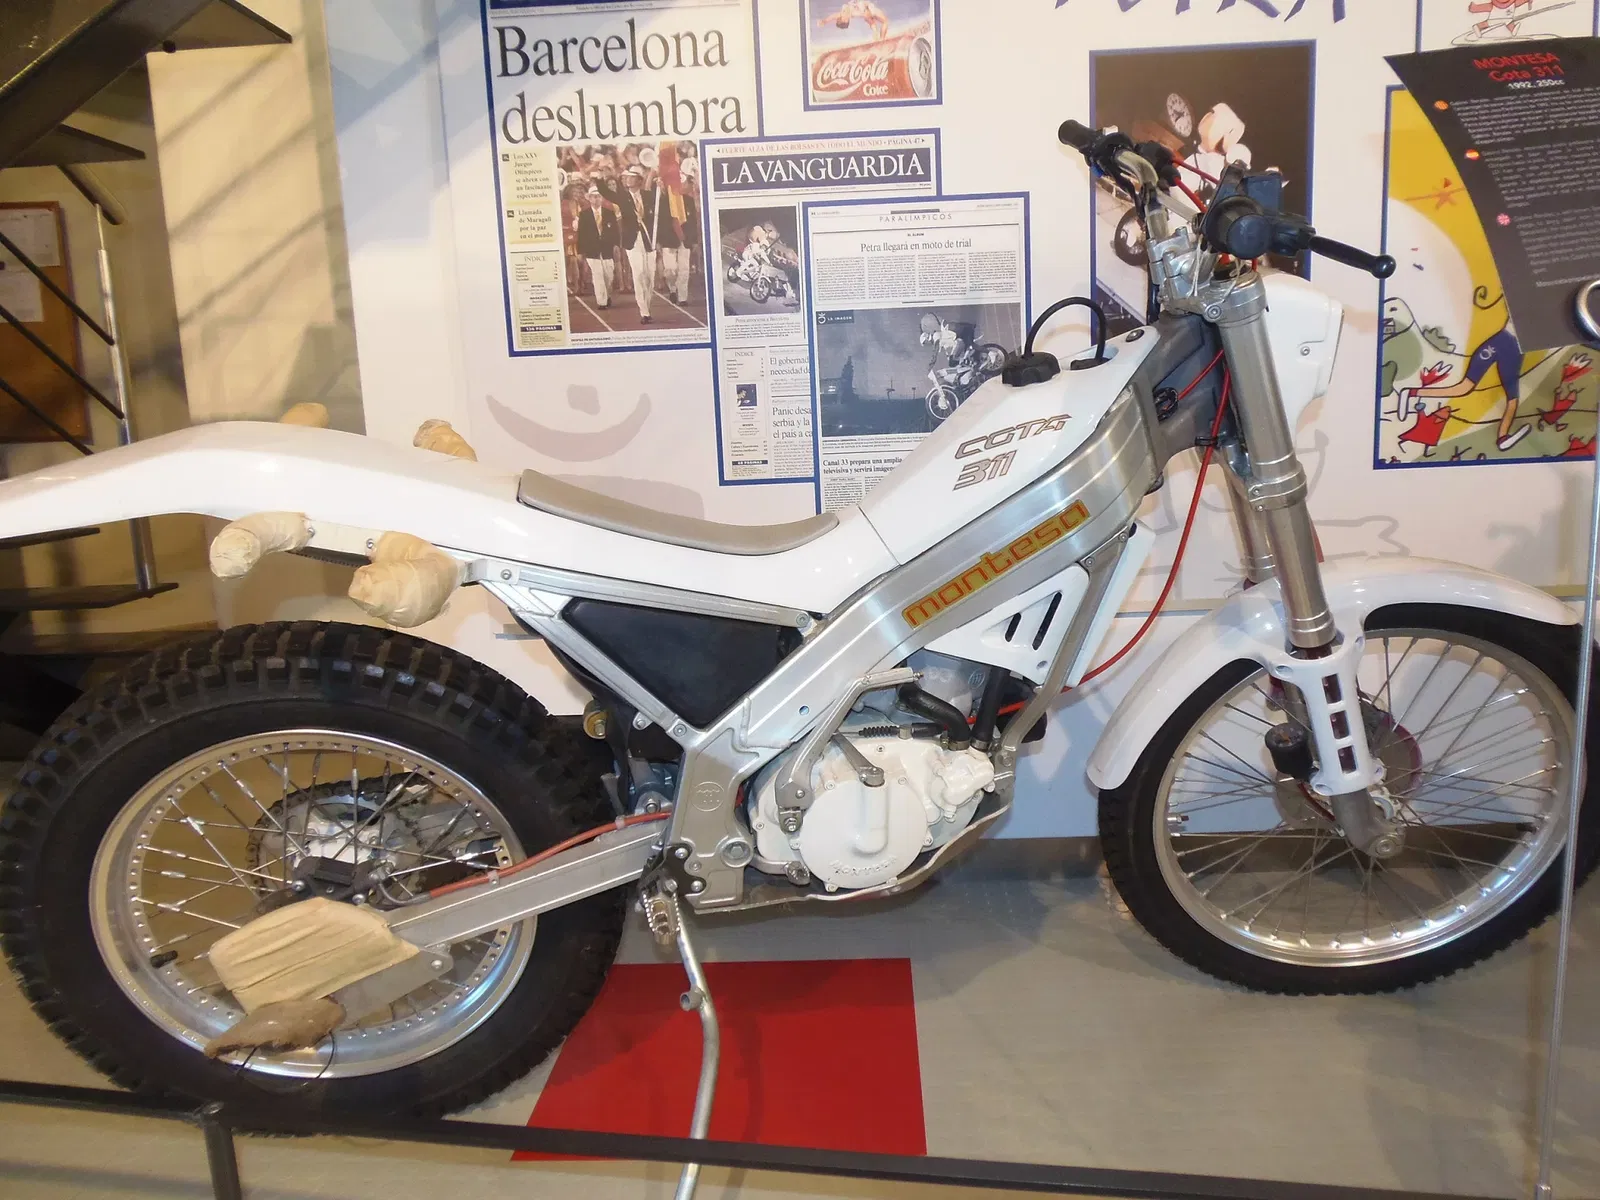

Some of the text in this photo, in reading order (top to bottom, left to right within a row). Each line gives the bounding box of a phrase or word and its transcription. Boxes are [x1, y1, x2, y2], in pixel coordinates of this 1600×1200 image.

[493, 17, 731, 78] Barcelona
[1473, 53, 1560, 69] MONTESA
[1488, 64, 1565, 82] Cota 311
[862, 83, 889, 97] Coke
[1536, 79, 1566, 87] 250cc
[502, 83, 747, 145] deslumbra
[857, 139, 882, 147] MUNDO
[721, 152, 925, 185] LA VANGUARDIA
[860, 243, 881, 252] Petra
[883, 241, 908, 252] llegará
[922, 242, 943, 250] moto
[944, 240, 954, 248] de
[955, 238, 972, 248] trial
[770, 357, 777, 365] El
[770, 366, 803, 376] necesidad
[772, 417, 810, 428] serbia y la
[773, 430, 780, 439] el
[954, 413, 1073, 460] COTA
[823, 459, 840, 467] Canal
[849, 458, 871, 467] prepara
[823, 466, 849, 474] televisiva
[854, 465, 873, 474] servirá
[952, 449, 1018, 492] 311
[904, 500, 1091, 629] montesa
